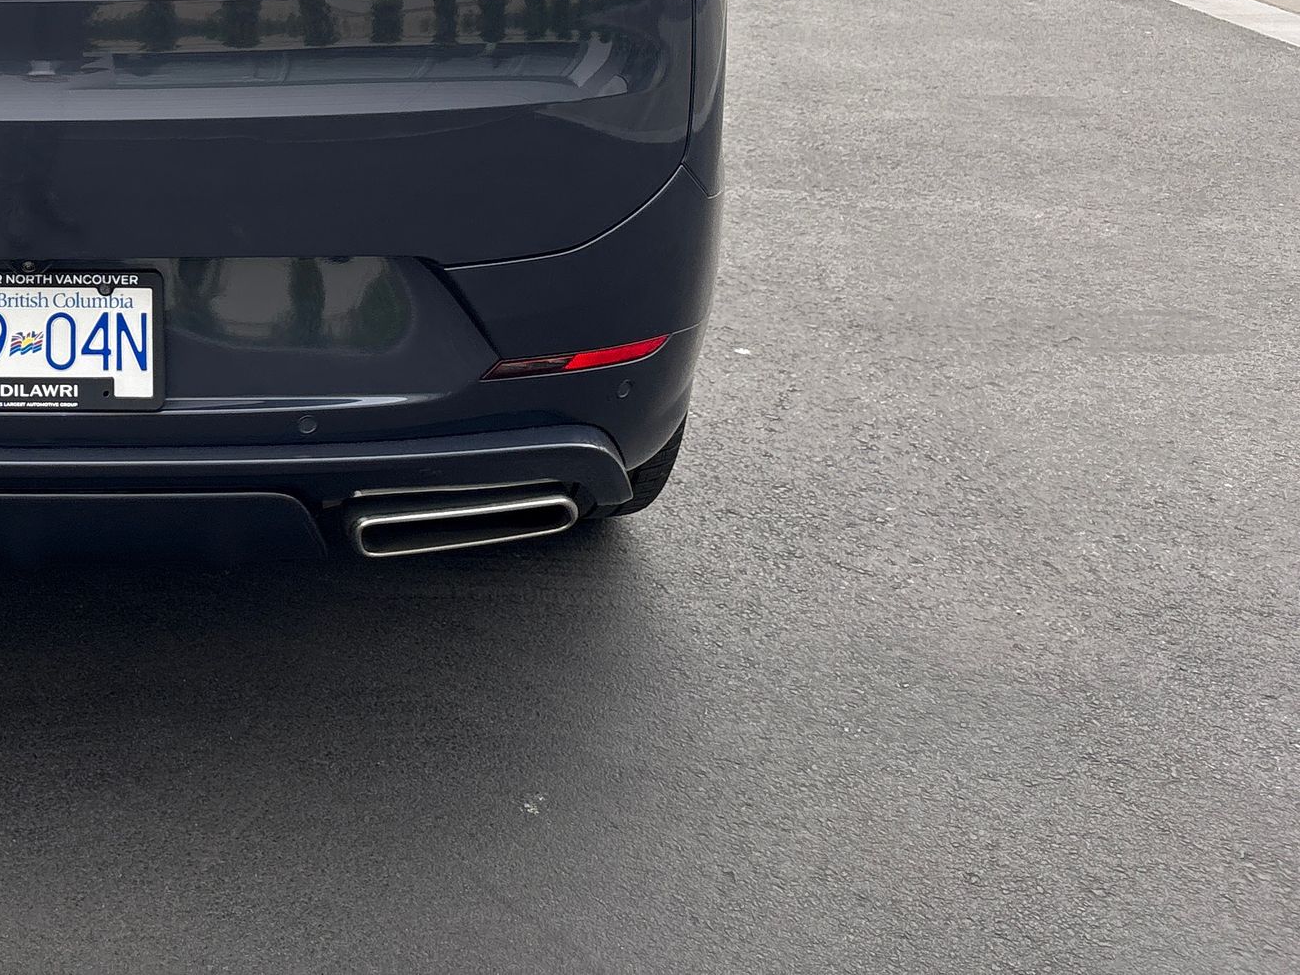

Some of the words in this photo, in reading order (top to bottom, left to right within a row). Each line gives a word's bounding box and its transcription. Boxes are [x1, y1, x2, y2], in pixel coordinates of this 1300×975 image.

[6, 275, 51, 285] NORTH
[55, 275, 139, 285] VANCOUVER
[52, 292, 134, 309] Columbia
[0, 384, 79, 398] DILAWRI
